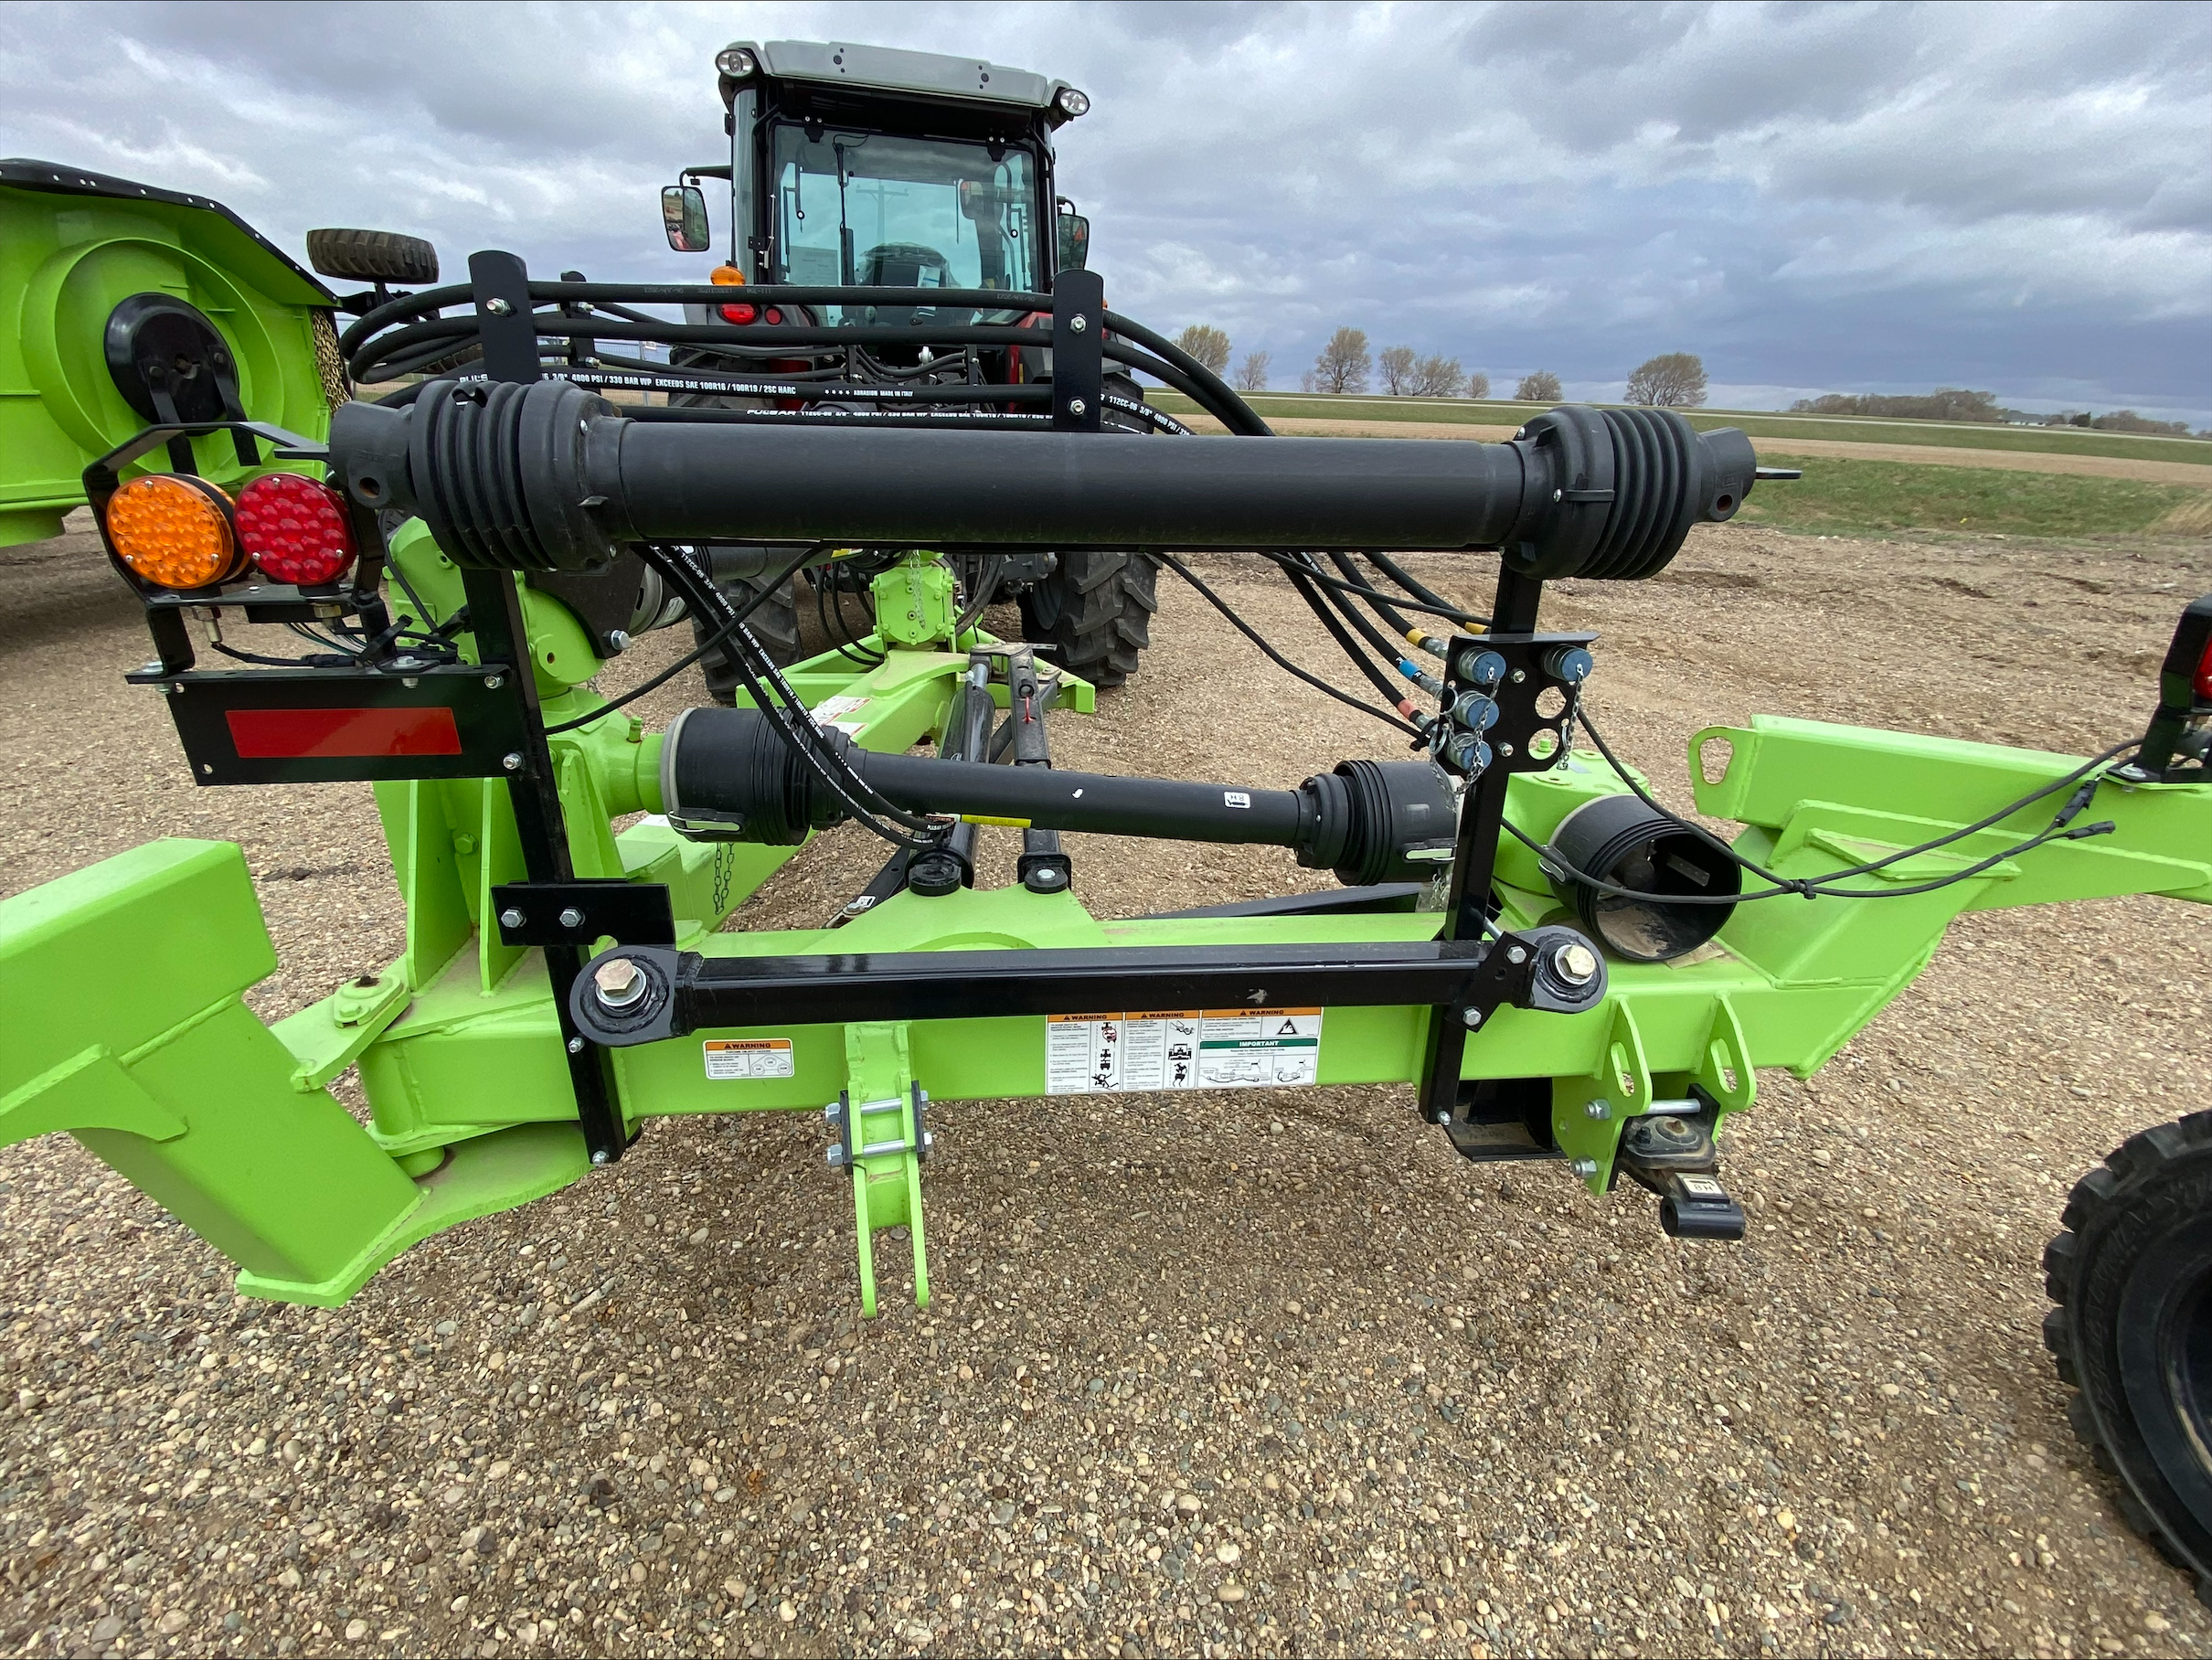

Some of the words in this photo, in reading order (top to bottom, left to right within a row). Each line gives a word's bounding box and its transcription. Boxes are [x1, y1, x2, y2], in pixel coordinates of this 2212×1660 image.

[571, 373, 590, 382] 4800
[590, 374, 603, 384] PSI
[609, 375, 623, 384] 330
[624, 377, 639, 386] BAR
[640, 378, 653, 386] WP
[654, 378, 684, 388] EXCEEDS
[686, 380, 698, 389] SAE
[731, 383, 758, 393] 100R19
[763, 384, 777, 394] 2SC
[778, 386, 796, 395] HARC
